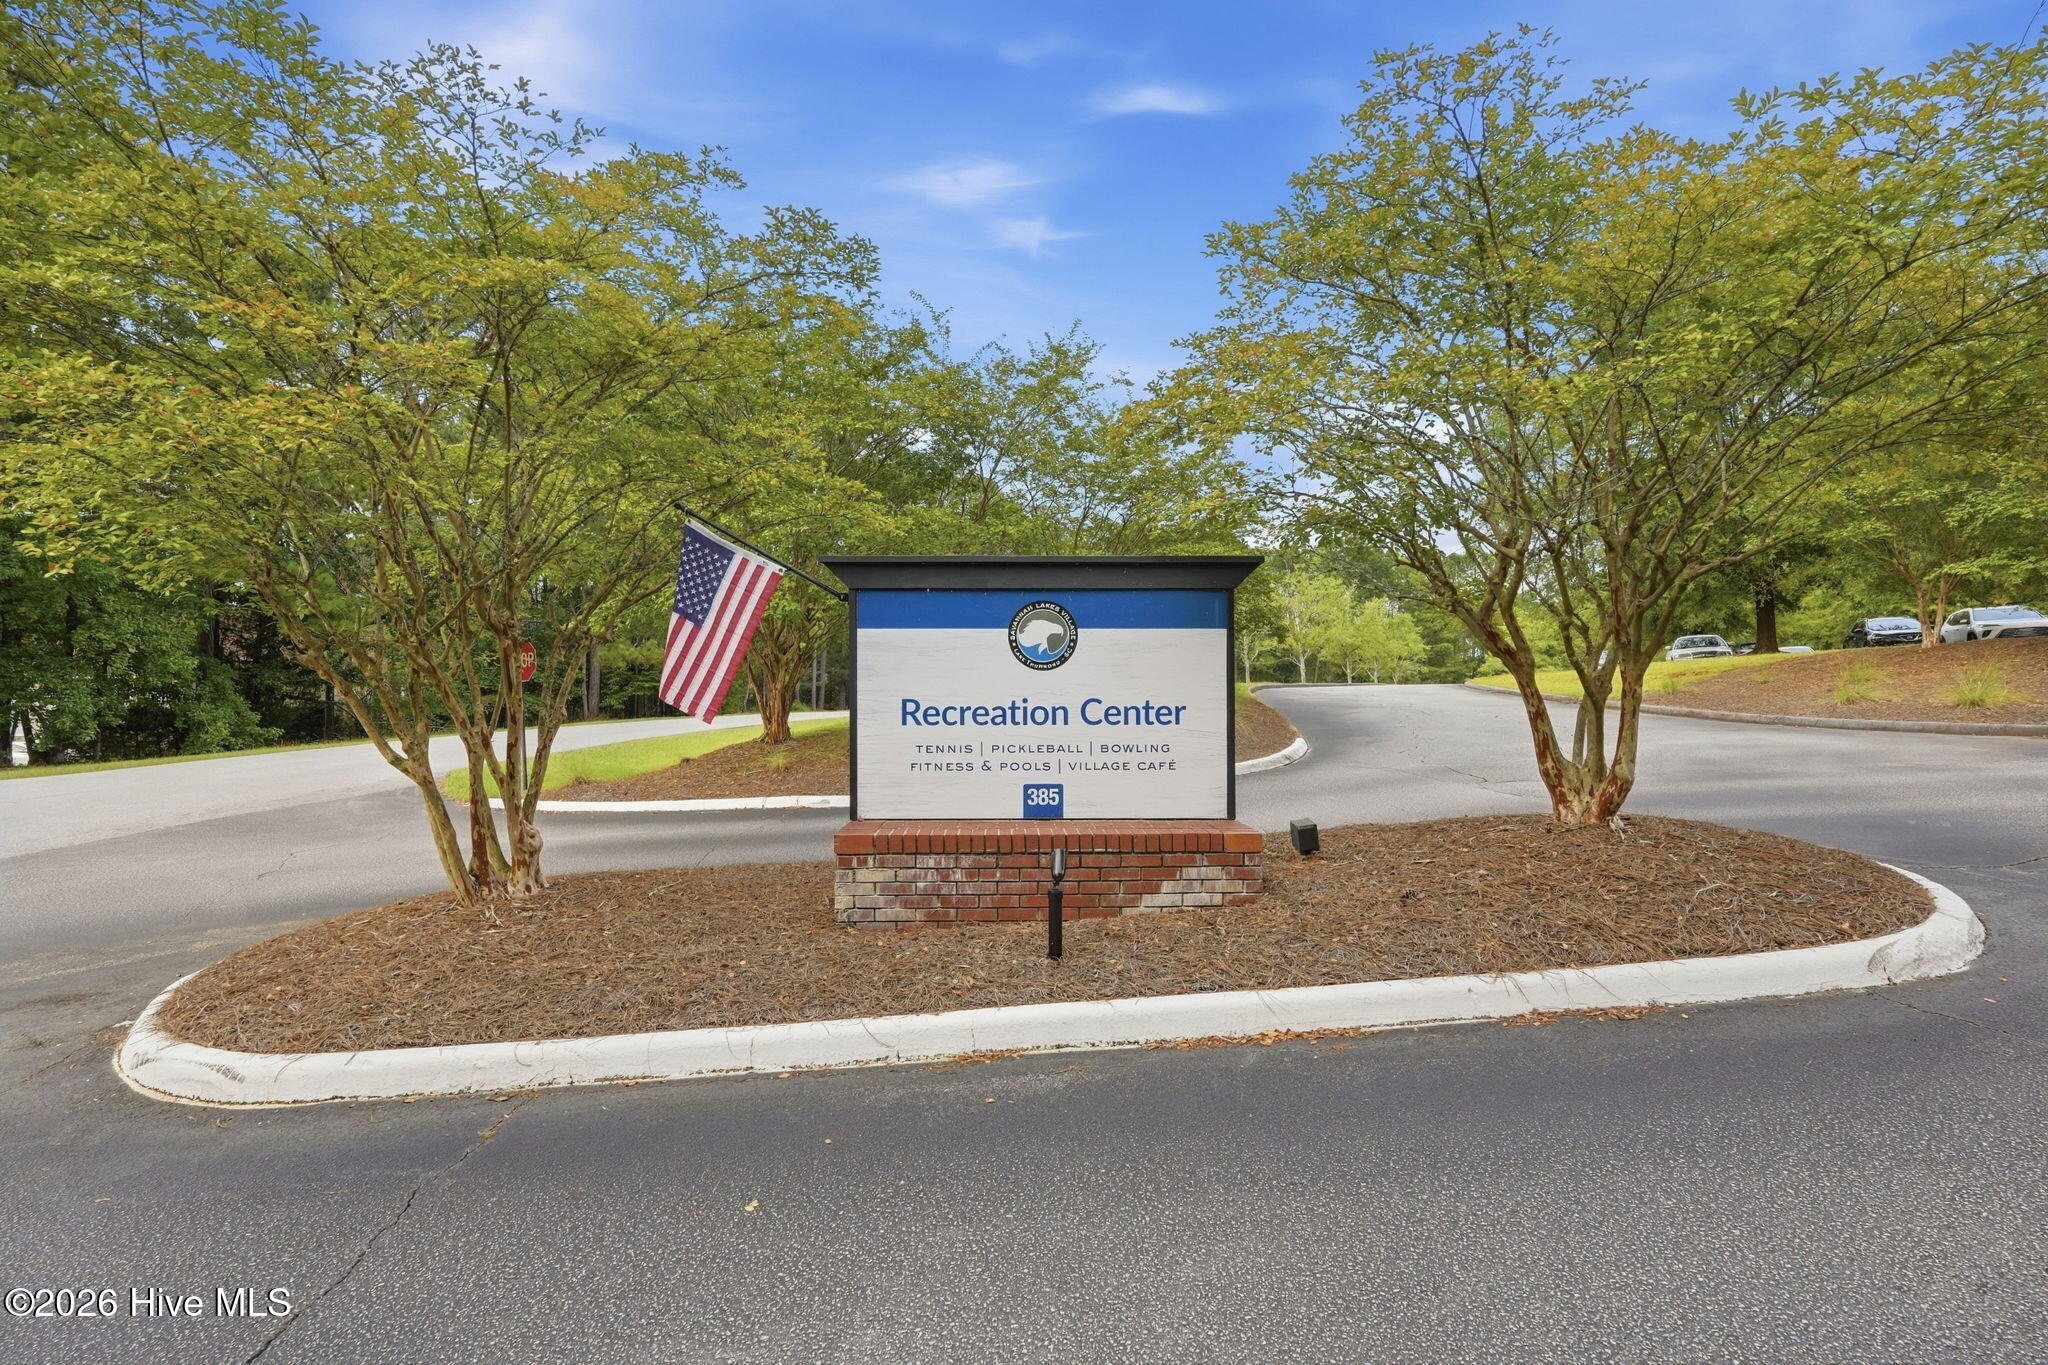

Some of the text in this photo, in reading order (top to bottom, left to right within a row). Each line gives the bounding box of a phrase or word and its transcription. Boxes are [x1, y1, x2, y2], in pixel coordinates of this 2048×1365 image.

[1035, 603, 1060, 612] LAKES
[1061, 610, 1076, 640] VILLAGE
[521, 652, 534, 667] OP
[901, 697, 1187, 726] Recreation Center
[915, 743, 1171, 754] TENNIS PICKLEBALL BOWLING
[910, 759, 1177, 772] FITNESS & POOLS VILLAGE CAFÉ
[1027, 788, 1060, 806] 385
